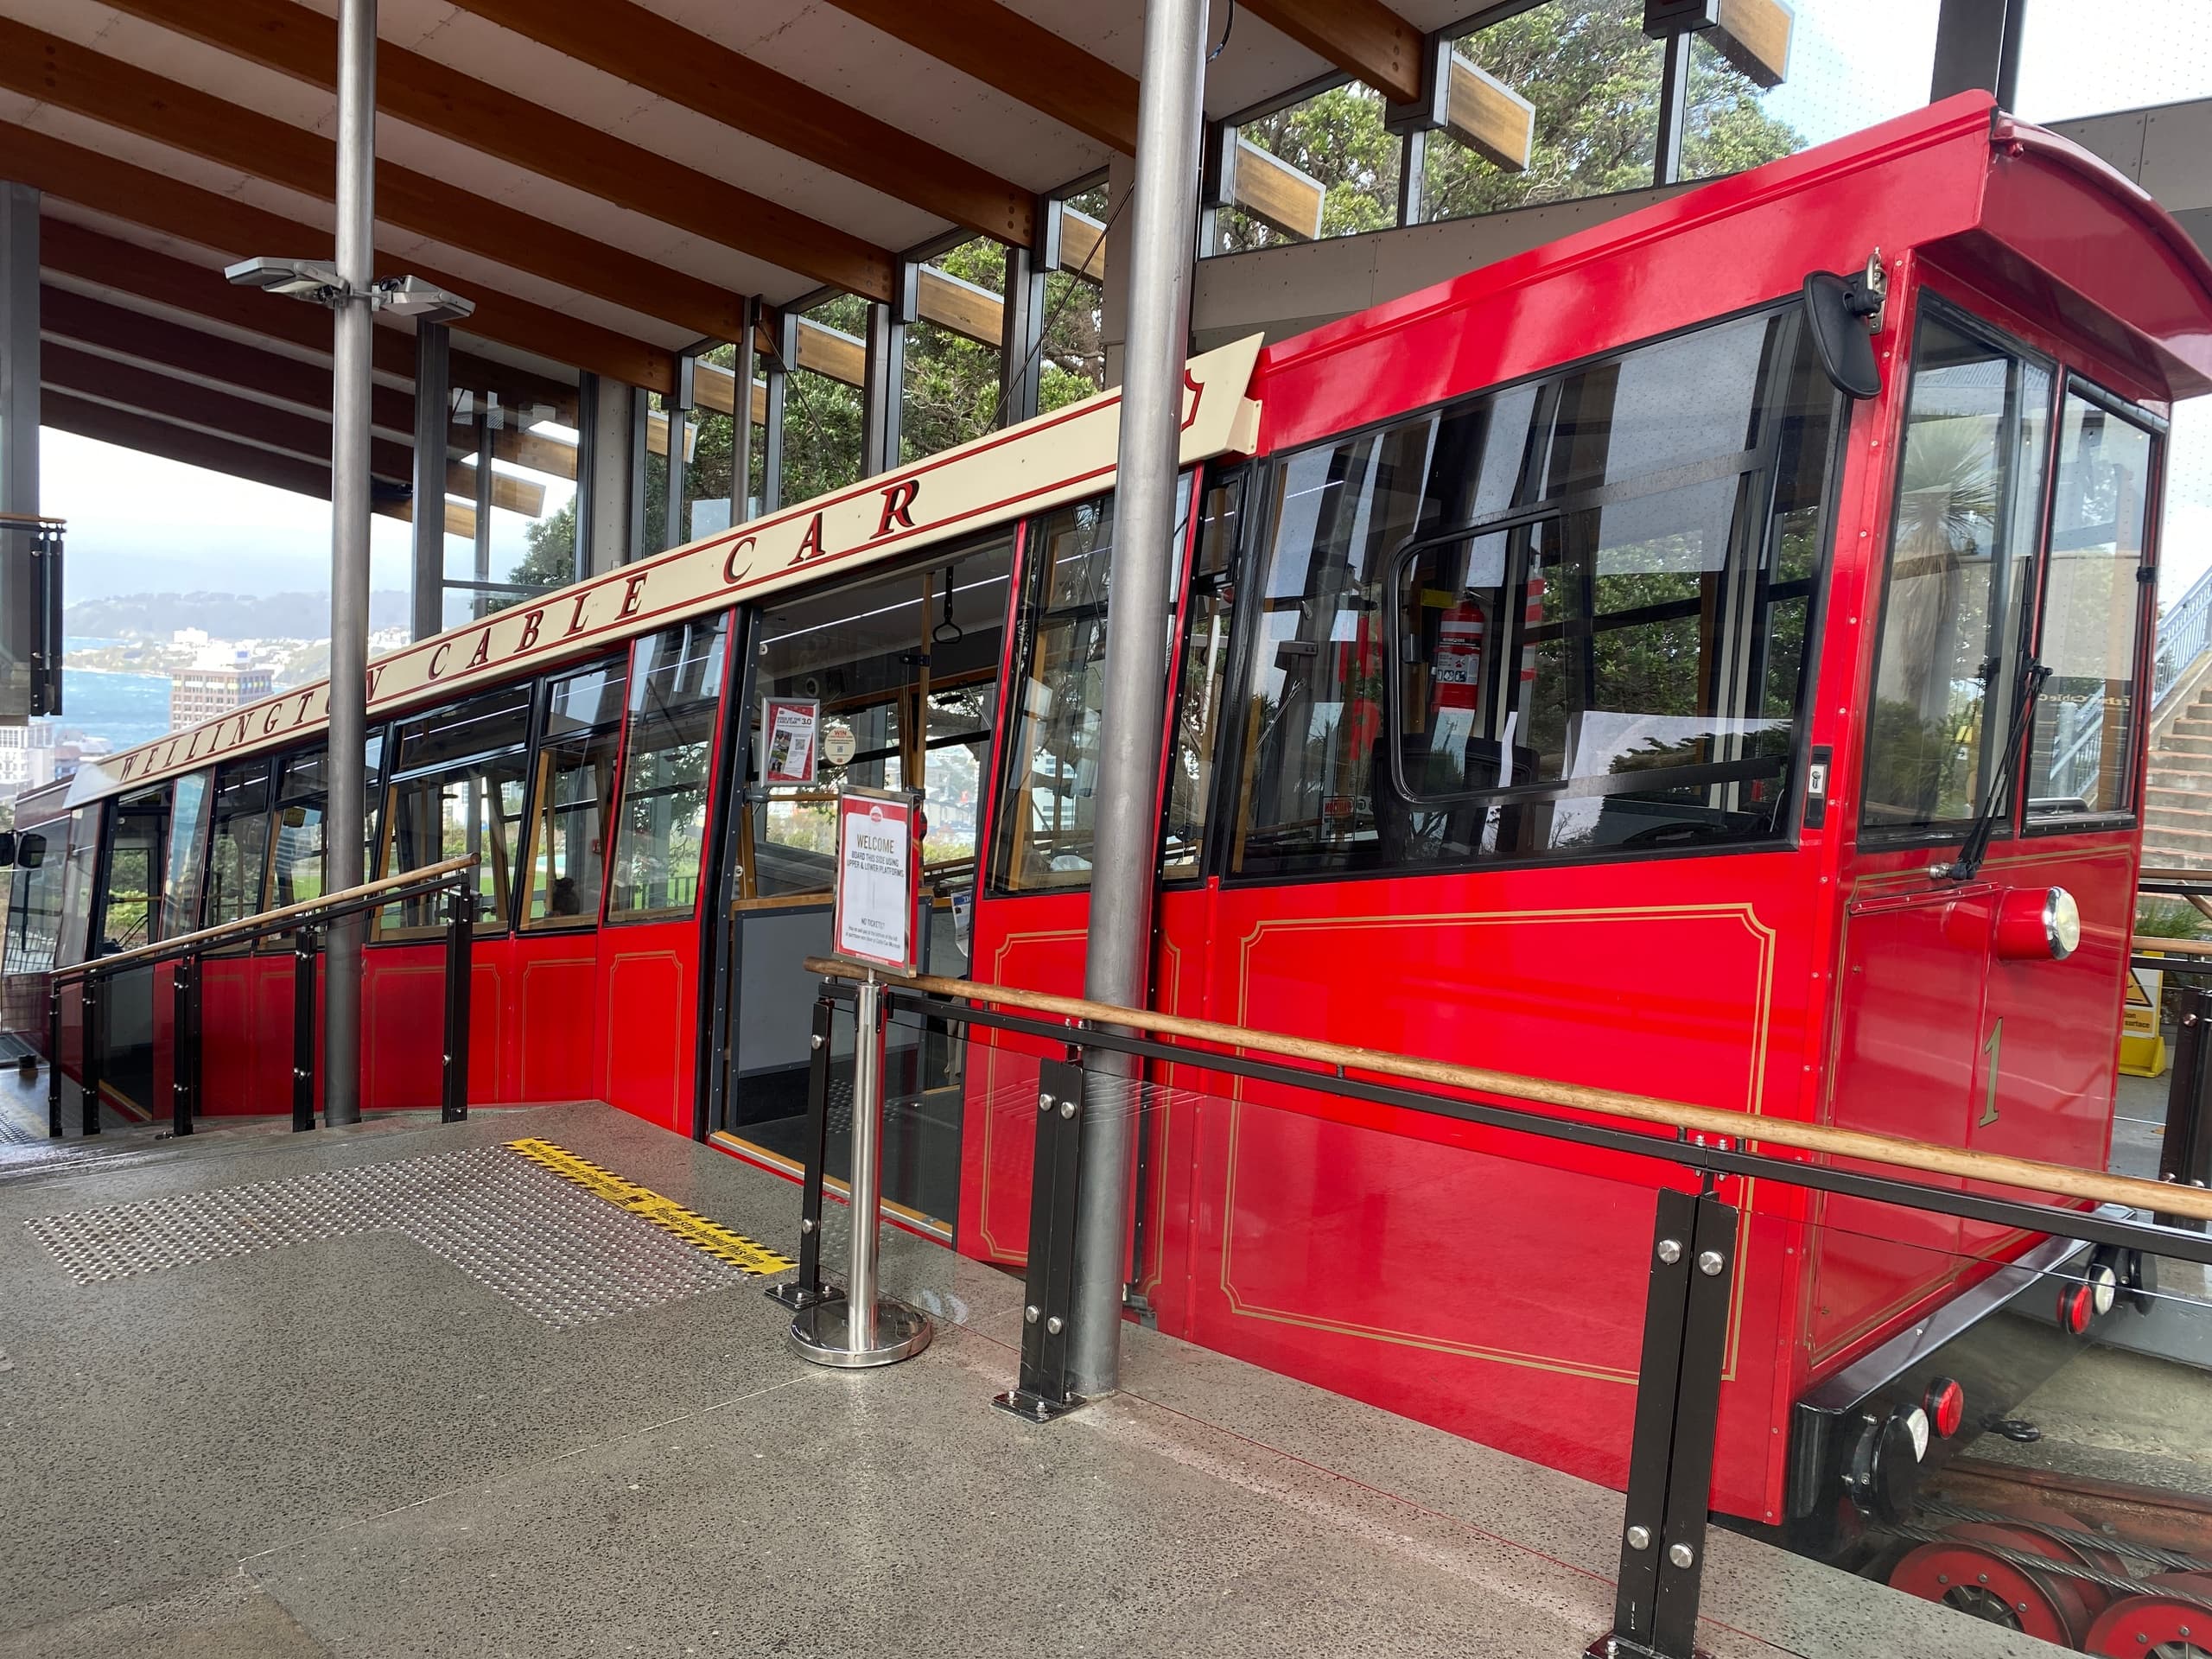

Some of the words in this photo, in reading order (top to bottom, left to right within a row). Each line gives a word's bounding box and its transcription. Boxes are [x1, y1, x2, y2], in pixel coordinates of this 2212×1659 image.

[119, 664, 386, 781] WELLINGTN
[428, 573, 649, 680] CABLE
[723, 480, 919, 584] CAR
[852, 850, 865, 861] BOARD
[866, 853, 875, 862] THIS
[875, 855, 886, 865] SIDE
[886, 857, 899, 868] USING
[857, 834, 894, 854] WELCOME
[847, 859, 860, 869] UPPER
[865, 862, 879, 873] LOWER
[879, 865, 904, 878] PLATFORMS
[1979, 1016, 2004, 1128] 1
[651, 1207, 682, 1223] Please
[696, 1230, 728, 1247] behind
[723, 1243, 747, 1255] this
[741, 1253, 765, 1266] line
